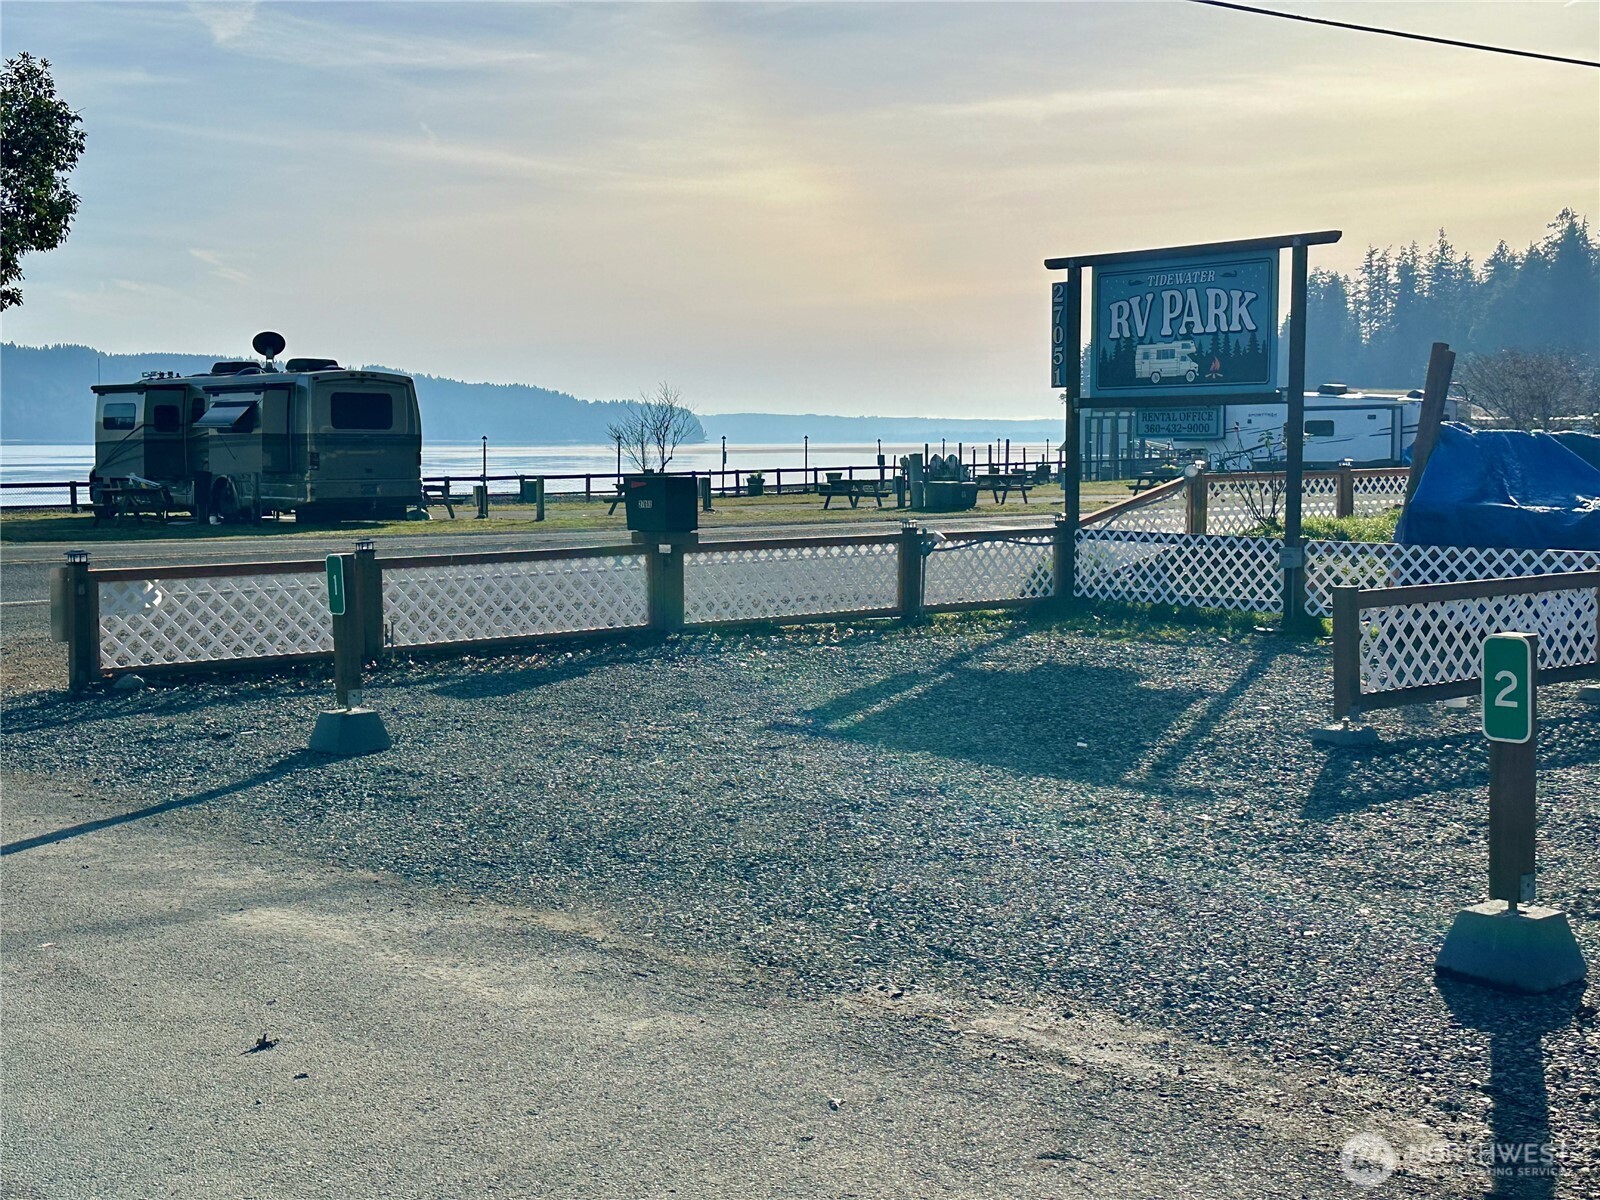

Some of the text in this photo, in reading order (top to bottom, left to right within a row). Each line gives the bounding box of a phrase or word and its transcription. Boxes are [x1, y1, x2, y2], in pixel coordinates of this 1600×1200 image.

[1147, 270, 1216, 287] TIDEWATER
[1109, 288, 1258, 338] RV PARK
[1052, 284, 1065, 386] 27051
[1141, 411, 1214, 422] RENTAL OFFICE
[1144, 423, 1210, 434] 360-432-9000
[333, 574, 338, 596] 1
[1494, 670, 1518, 708] 2
